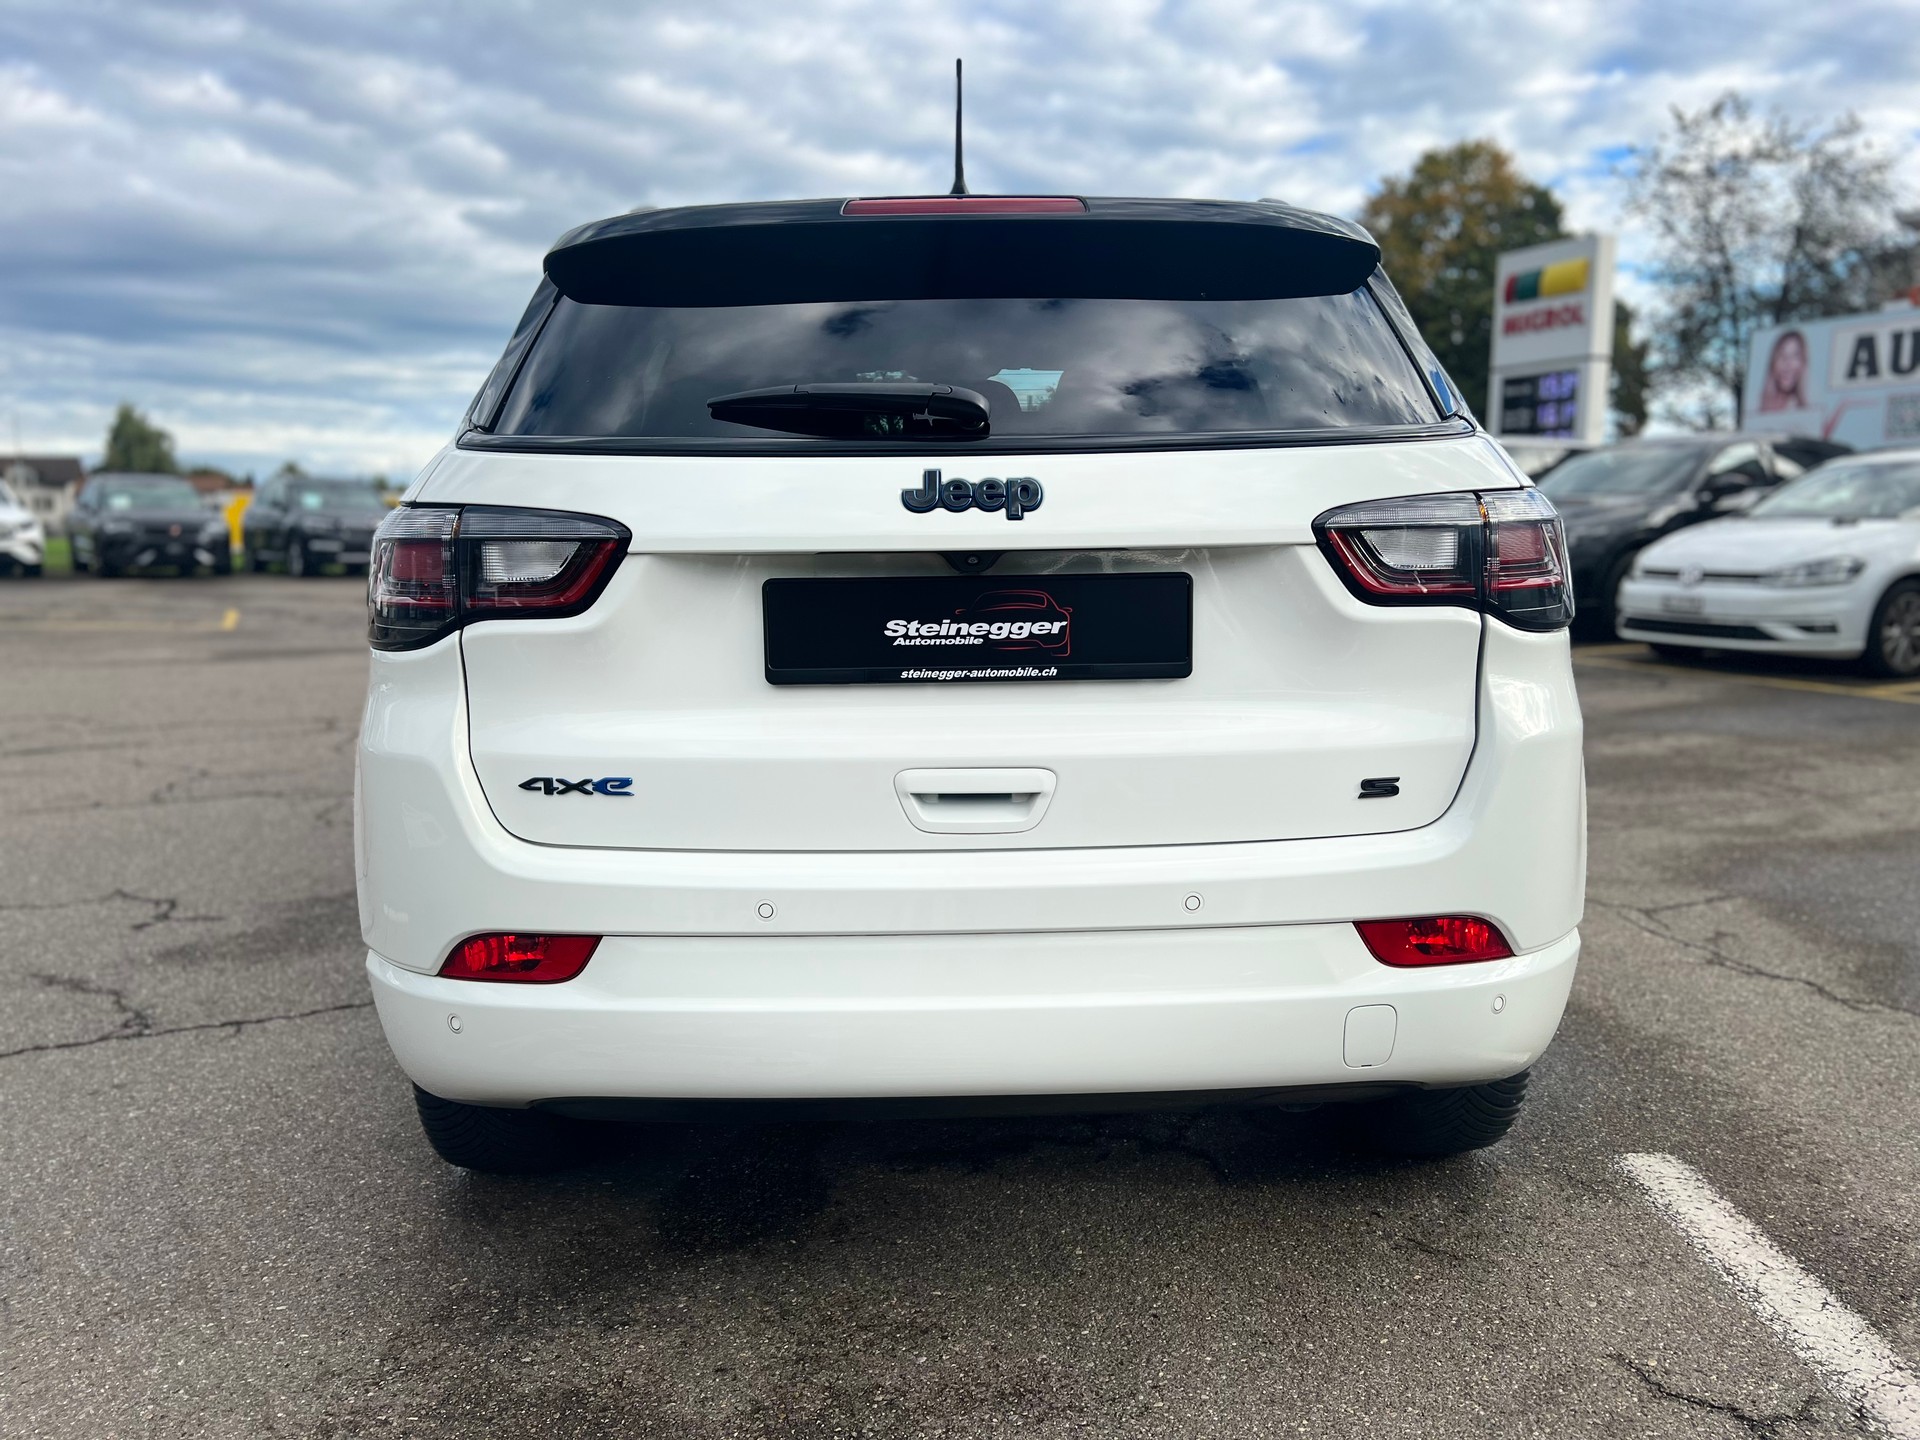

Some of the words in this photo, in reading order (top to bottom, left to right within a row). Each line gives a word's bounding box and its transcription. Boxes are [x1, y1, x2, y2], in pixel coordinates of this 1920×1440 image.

[901, 469, 1043, 520] Jeep
[884, 619, 1067, 639] Steinegger
[893, 636, 983, 646] Automobile
[900, 667, 1057, 680] steinegger-automobile.ch
[1357, 776, 1400, 799] S
